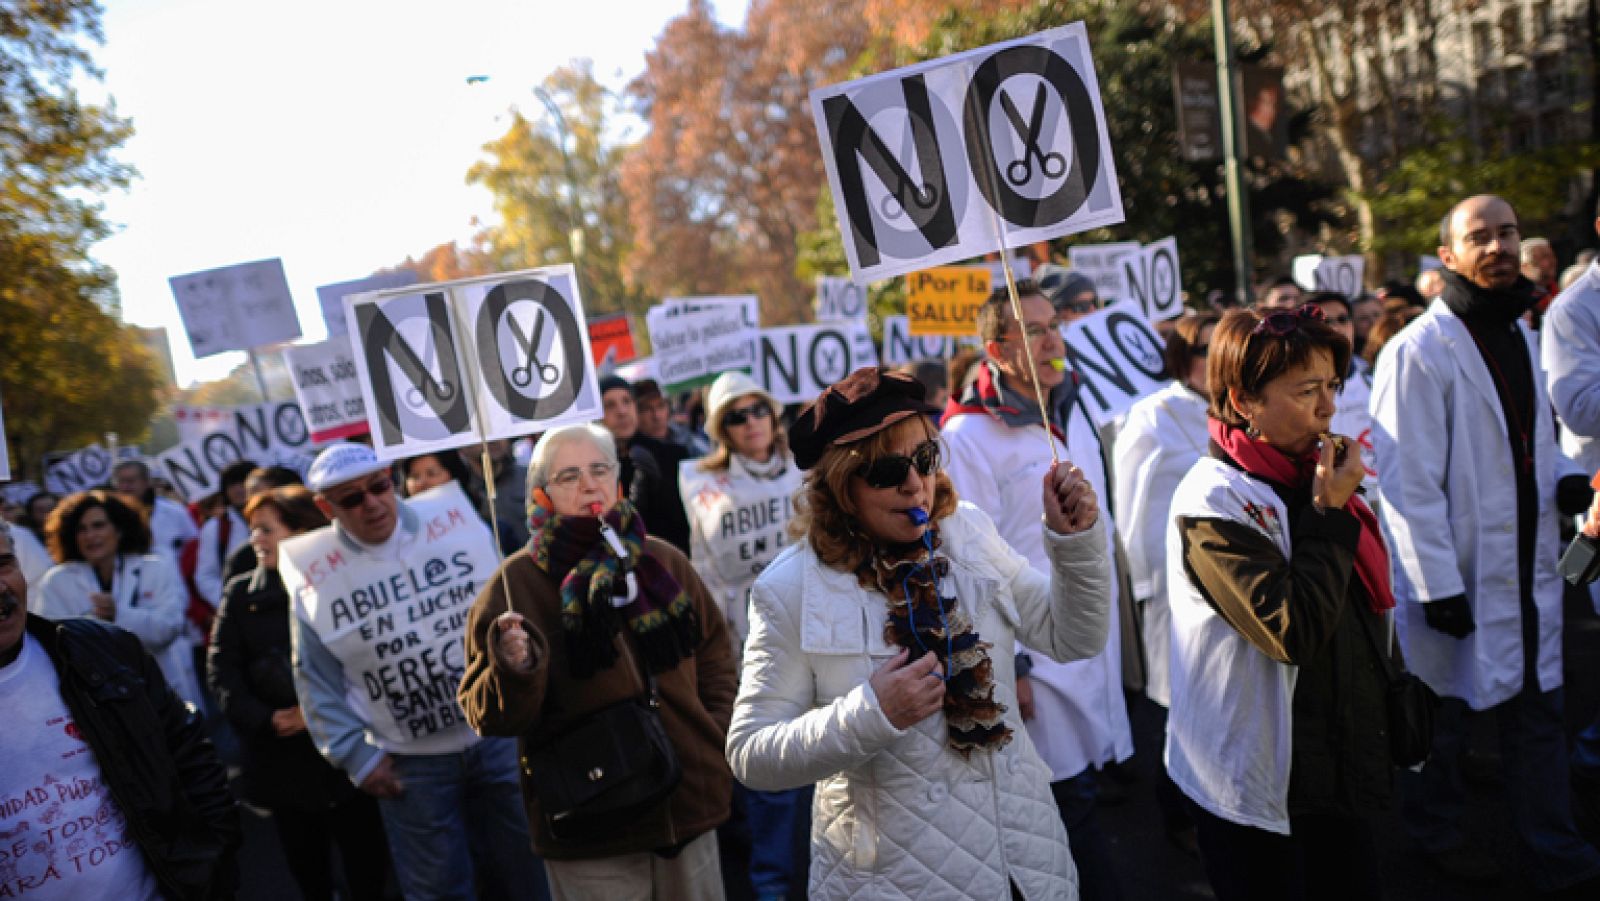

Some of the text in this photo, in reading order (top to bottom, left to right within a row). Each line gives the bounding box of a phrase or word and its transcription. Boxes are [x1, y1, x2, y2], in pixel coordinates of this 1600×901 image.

[822, 46, 1100, 268] NO
[823, 282, 863, 317] NO
[967, 274, 986, 292] la
[1125, 247, 1175, 319] NO
[353, 279, 584, 445] NO
[760, 329, 852, 394] NO
[1064, 311, 1169, 411] NO
[235, 402, 309, 450] NO
[56, 449, 108, 493] NO
[165, 433, 243, 497] NO
[331, 551, 474, 632] ABUEL@S
[359, 581, 475, 641] EN LUCHA
[375, 632, 421, 660] POR
